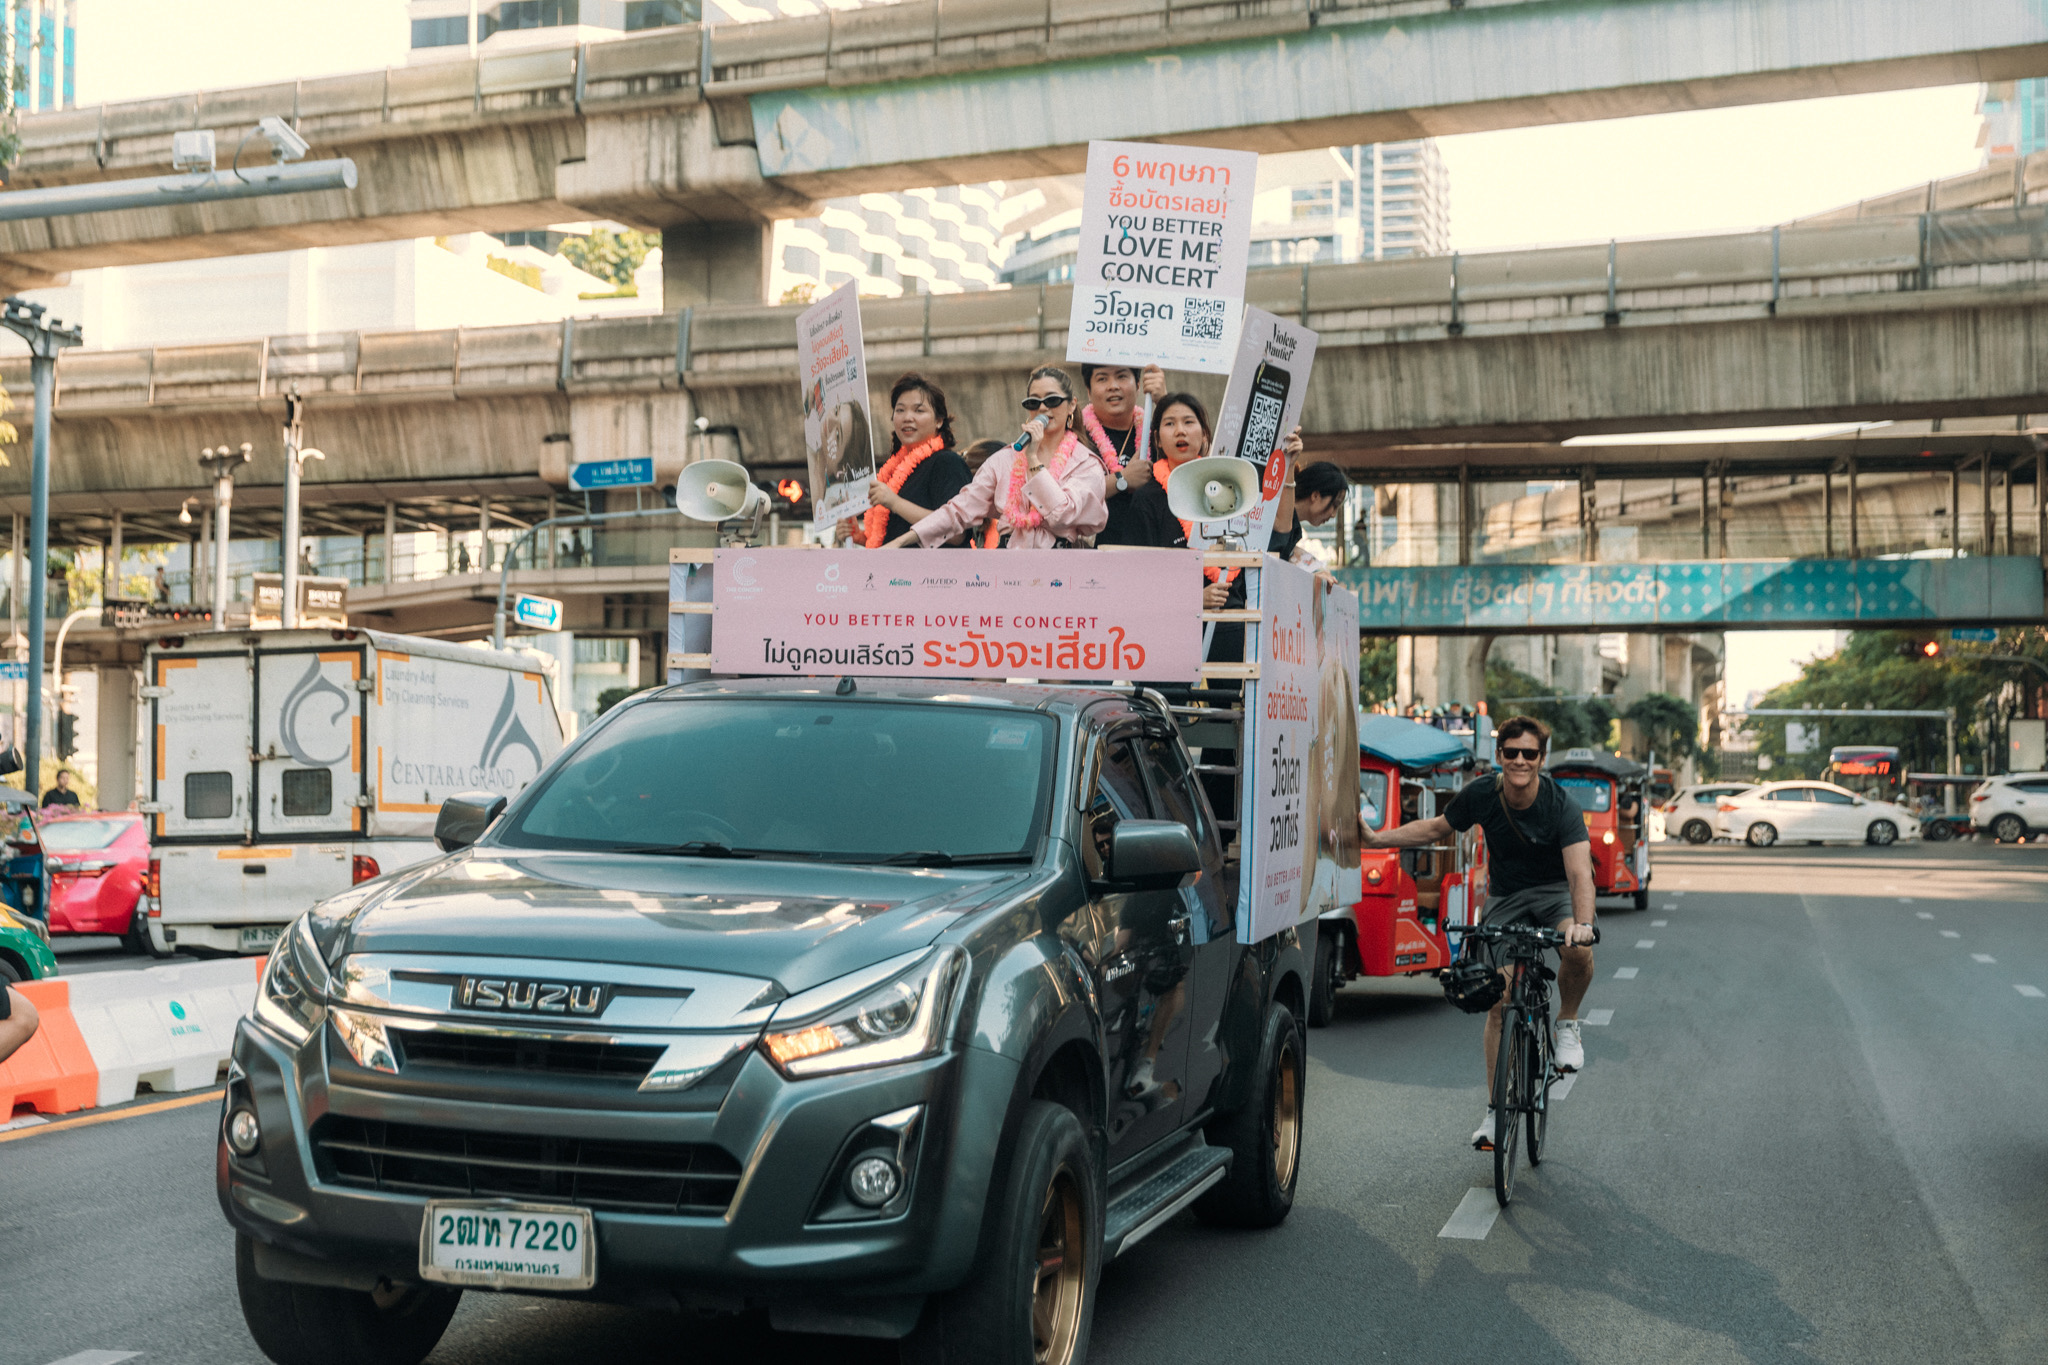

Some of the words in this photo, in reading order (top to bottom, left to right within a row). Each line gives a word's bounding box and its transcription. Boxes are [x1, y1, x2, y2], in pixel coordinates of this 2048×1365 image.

[1112, 155, 1130, 178] 6
[1136, 160, 1231, 187] พฤษภา
[1108, 180, 1228, 219] ซื้อบัตรเลย!
[1107, 214, 1147, 231] YOU
[1152, 217, 1224, 238] BETTER
[1102, 234, 1174, 260] LOVE
[1180, 240, 1222, 264] ME
[1100, 262, 1220, 290] CONCERT
[1093, 290, 1174, 321] วิโอเลต
[1085, 317, 1150, 337] วอเทียร์
[1271, 457, 1280, 477] 6
[816, 583, 849, 593] Omne
[804, 613, 839, 626] YOU
[848, 614, 915, 627] BETTER
[924, 615, 970, 627] LOVE
[979, 615, 1004, 628] ME
[1013, 616, 1099, 629] CONCERT
[763, 638, 915, 671] ไม่ดูคอนเสิร์ตวี
[922, 626, 1146, 670] ระวังจะเสียใจ
[1272, 614, 1279, 661] 6
[385, 667, 419, 684] Laundry
[420, 672, 436, 685] And
[385, 687, 400, 702] Dry
[401, 689, 436, 709] Cleaning
[438, 694, 469, 710] Services
[390, 754, 466, 787] CENTARA
[468, 764, 515, 790] GRAND
[1271, 733, 1301, 798] วิโอเลต
[1269, 798, 1300, 853] วอเทียร์
[463, 978, 601, 1014] ISUZU
[508, 1217, 577, 1251] 7220
